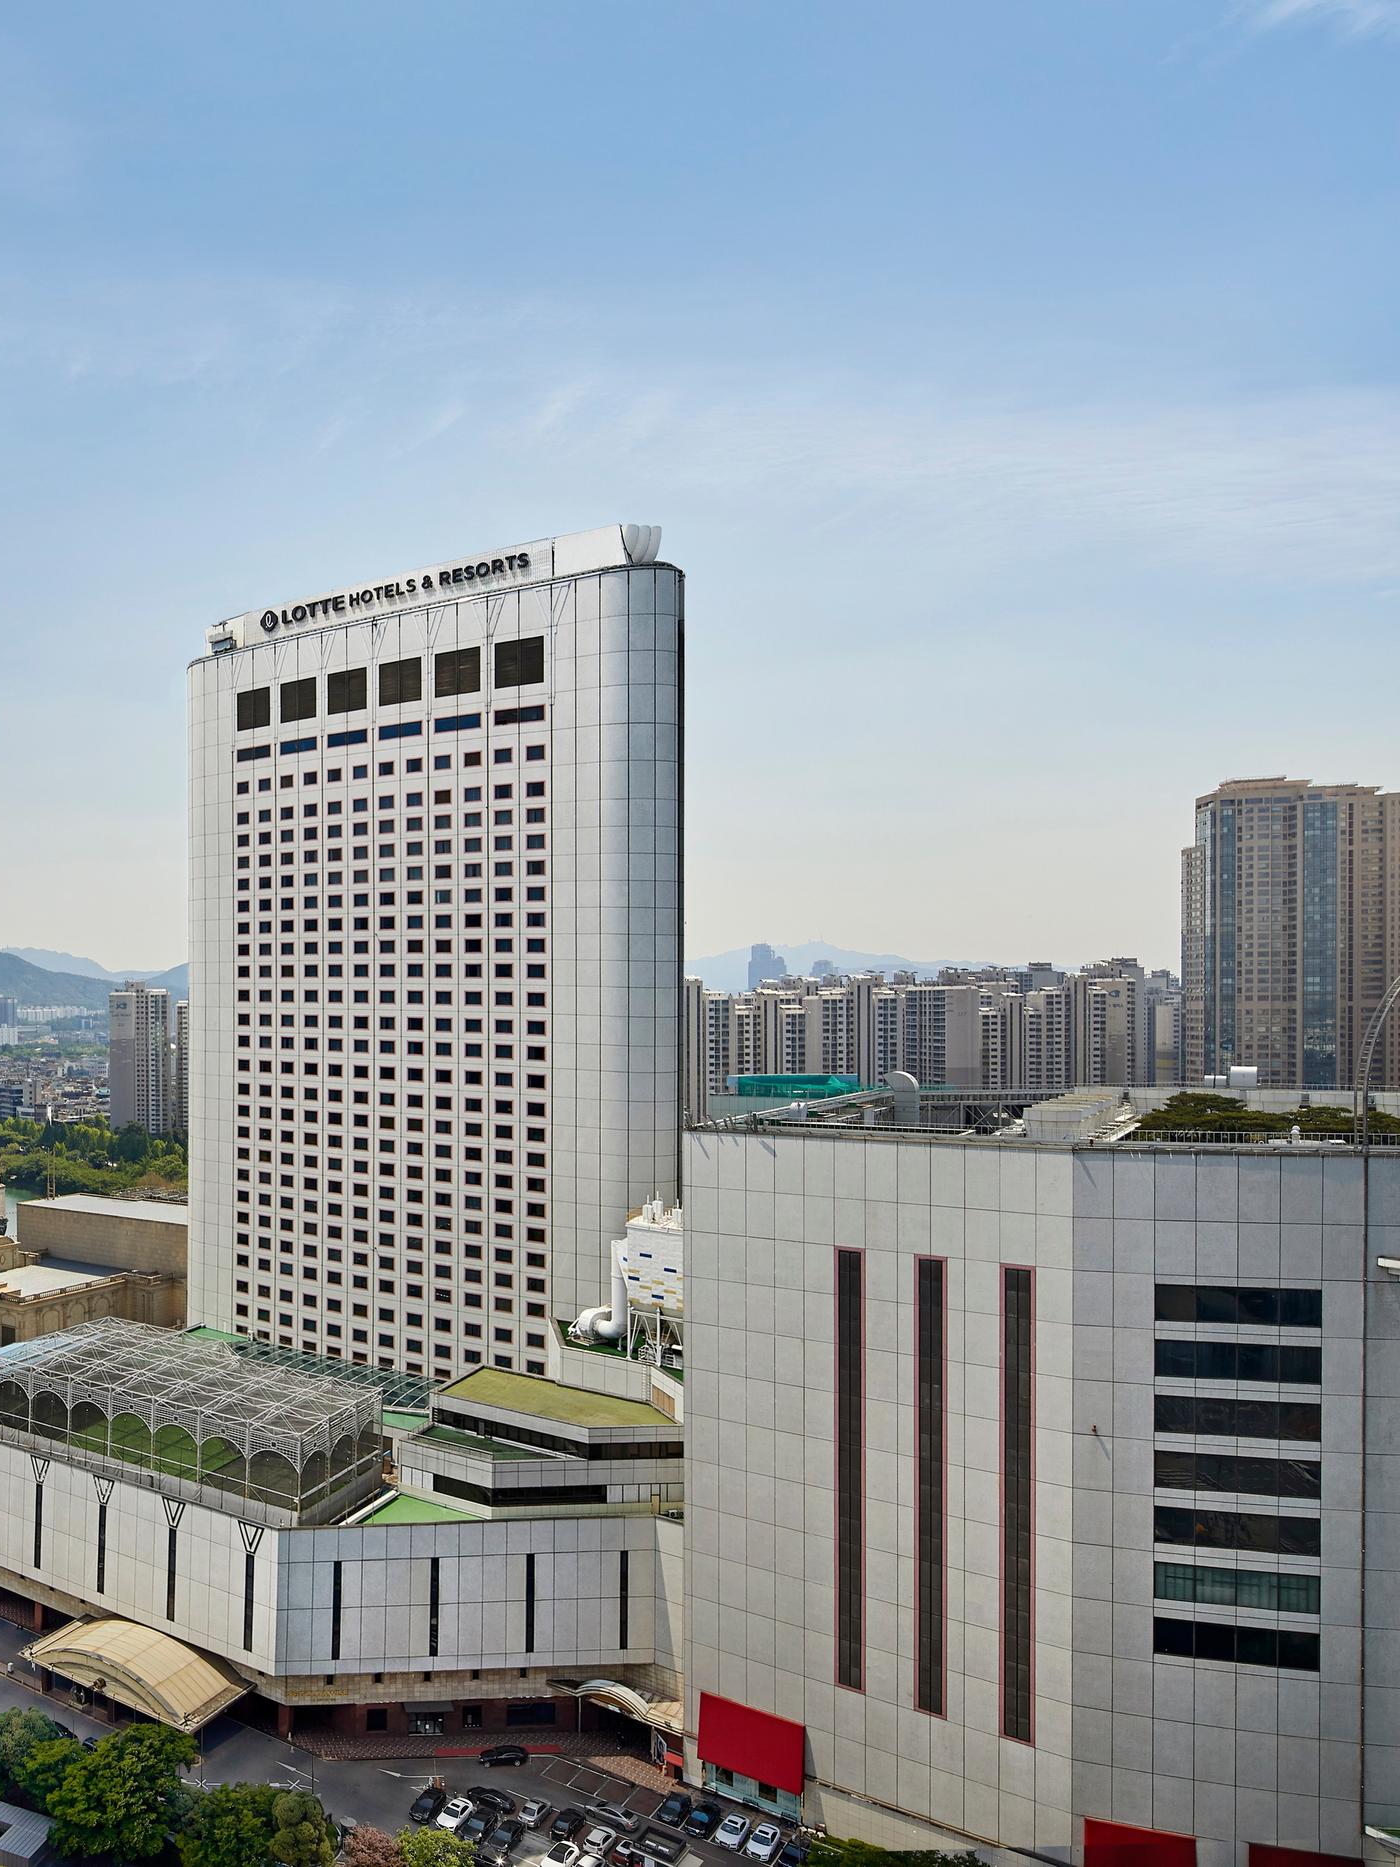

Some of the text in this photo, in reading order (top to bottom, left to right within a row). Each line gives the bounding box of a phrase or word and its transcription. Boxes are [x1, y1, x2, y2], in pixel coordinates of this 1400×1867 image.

[281, 552, 530, 625] LOTTE HOTELS & RESORTS
